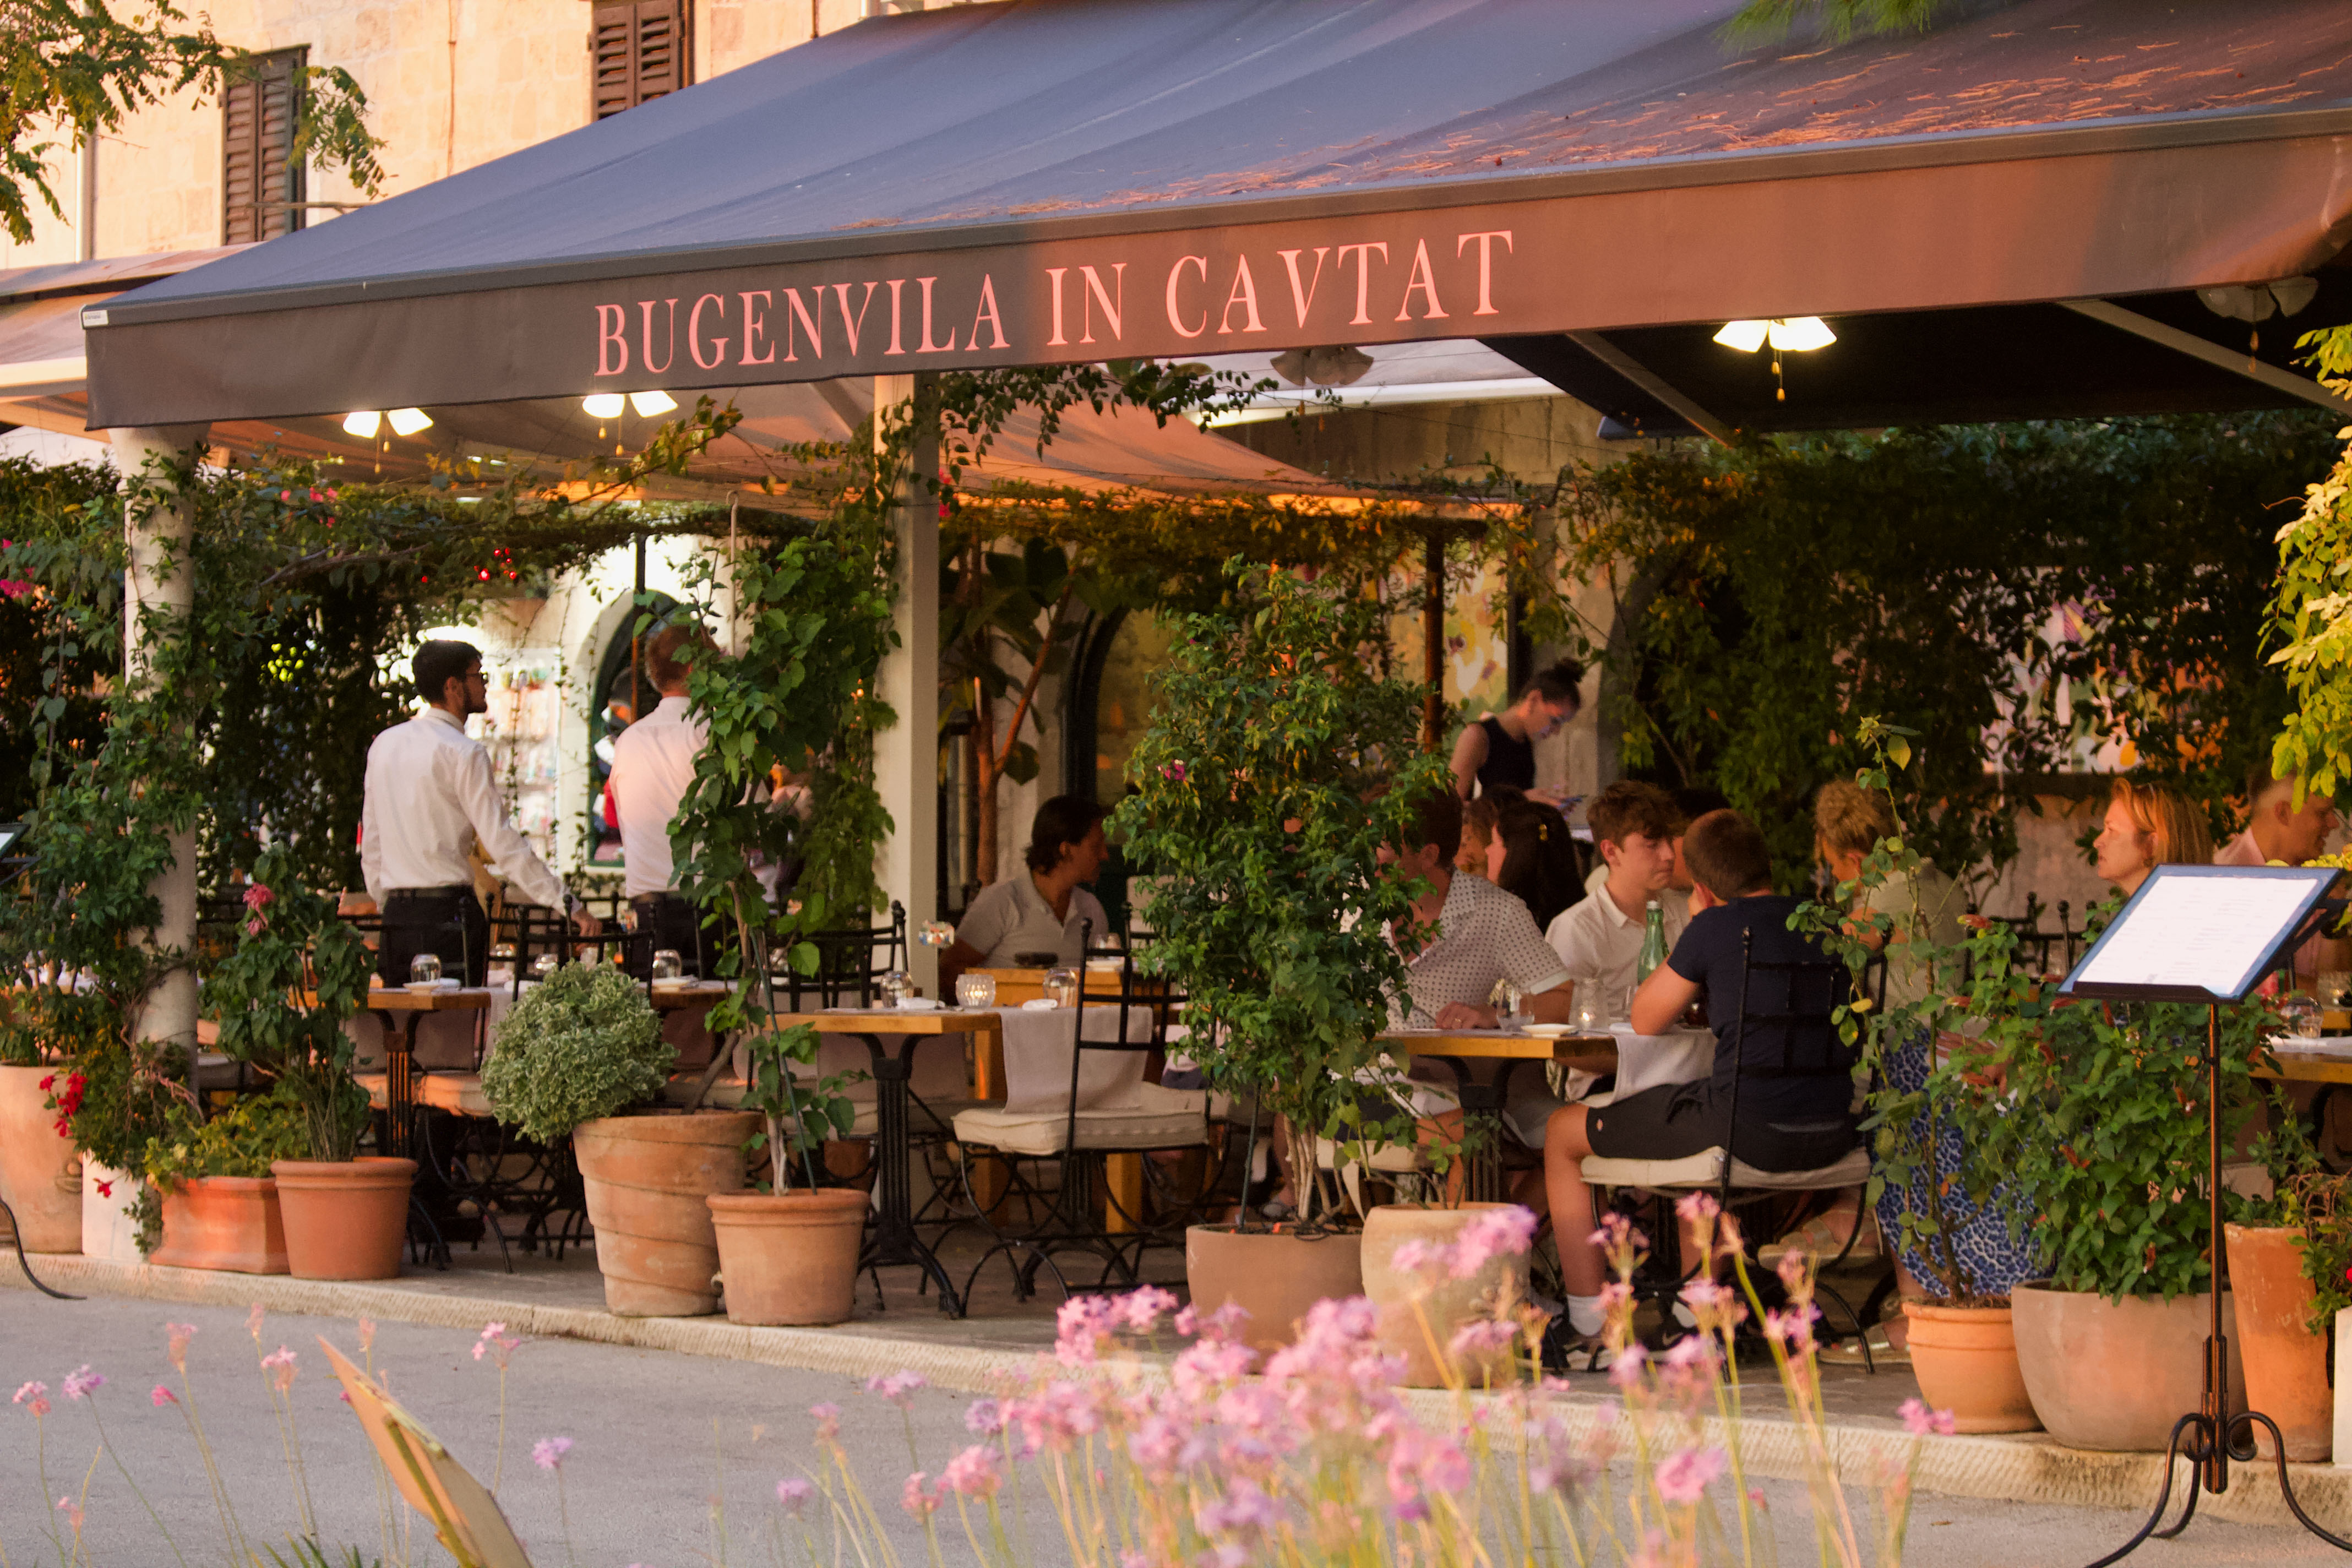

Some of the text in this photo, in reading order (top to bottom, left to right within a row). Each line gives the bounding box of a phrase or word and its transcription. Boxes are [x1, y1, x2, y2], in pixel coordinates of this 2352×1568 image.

[594, 230, 1513, 377] BUGENVILA IN CAVTAT
